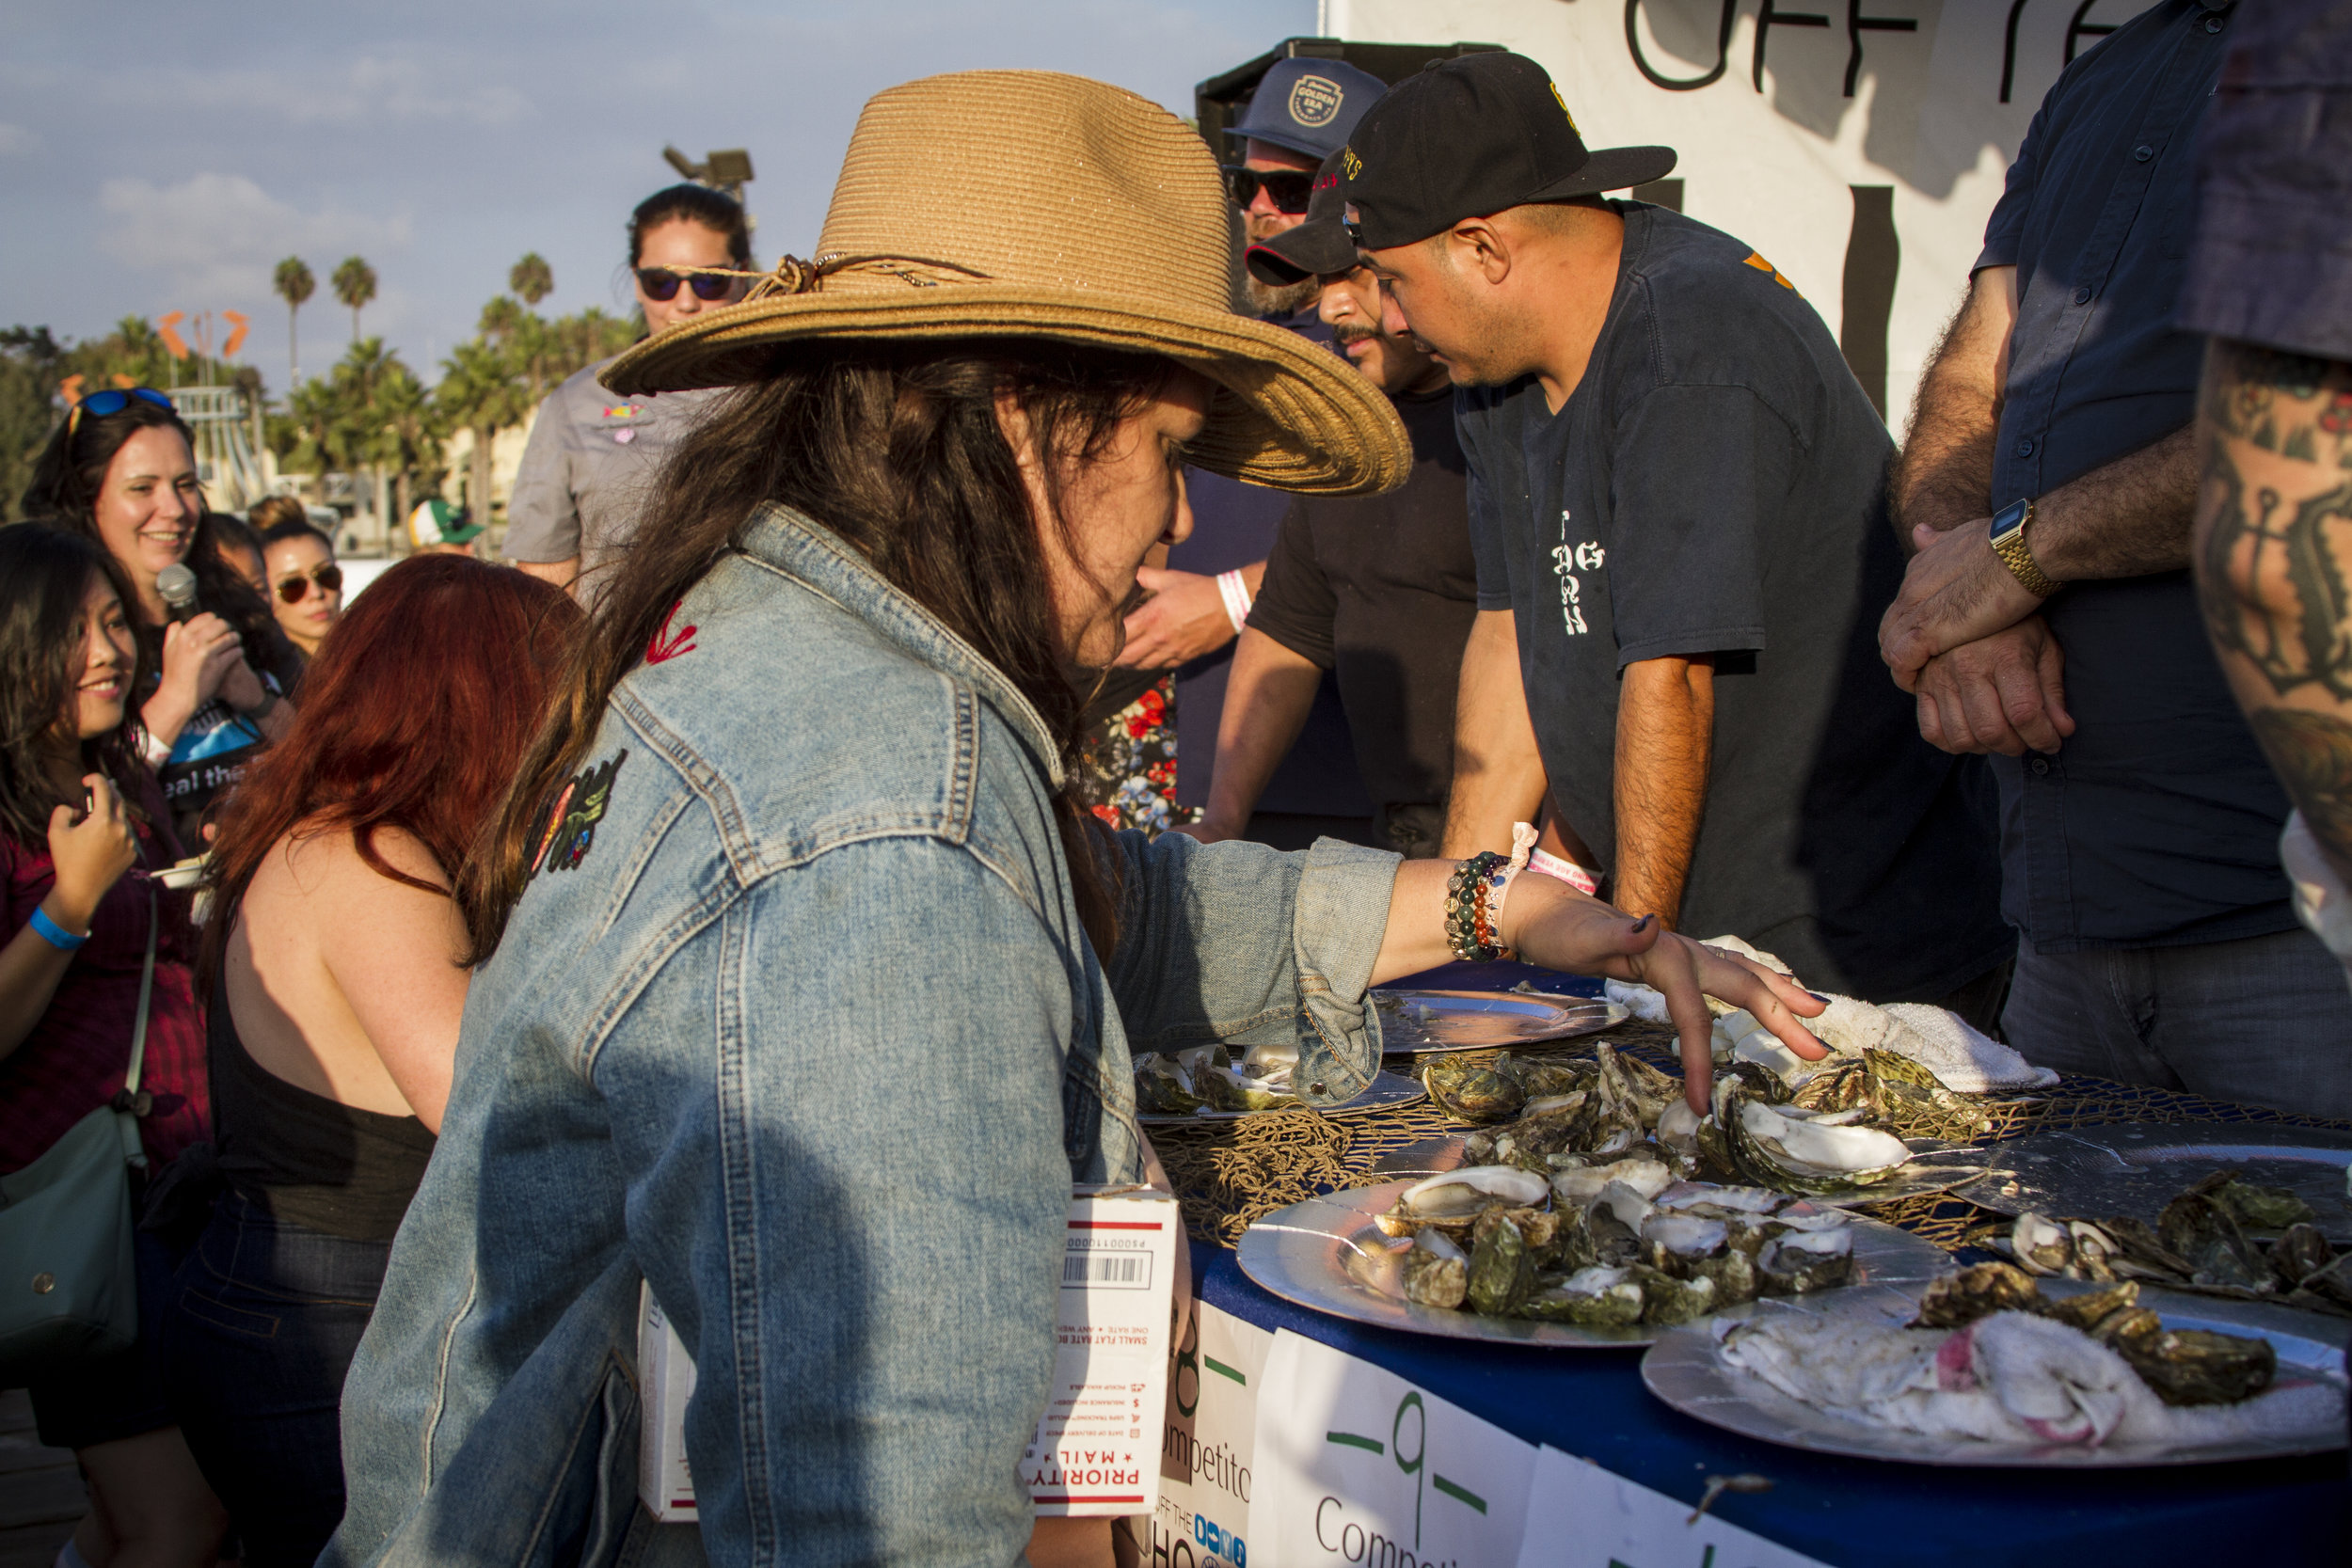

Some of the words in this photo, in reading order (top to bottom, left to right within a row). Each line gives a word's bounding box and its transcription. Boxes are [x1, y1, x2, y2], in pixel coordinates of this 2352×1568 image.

[1298, 87, 1336, 106] GOLDEN
[1304, 97, 1324, 111] ERA
[1071, 1335, 1092, 1344] RATE
[1095, 1336, 1117, 1345] FLAT
[1119, 1336, 1148, 1345] SMALL
[1060, 1450, 1115, 1464] MAIL
[1158, 1495, 1170, 1518] FF
[1173, 1503, 1192, 1535] THE
